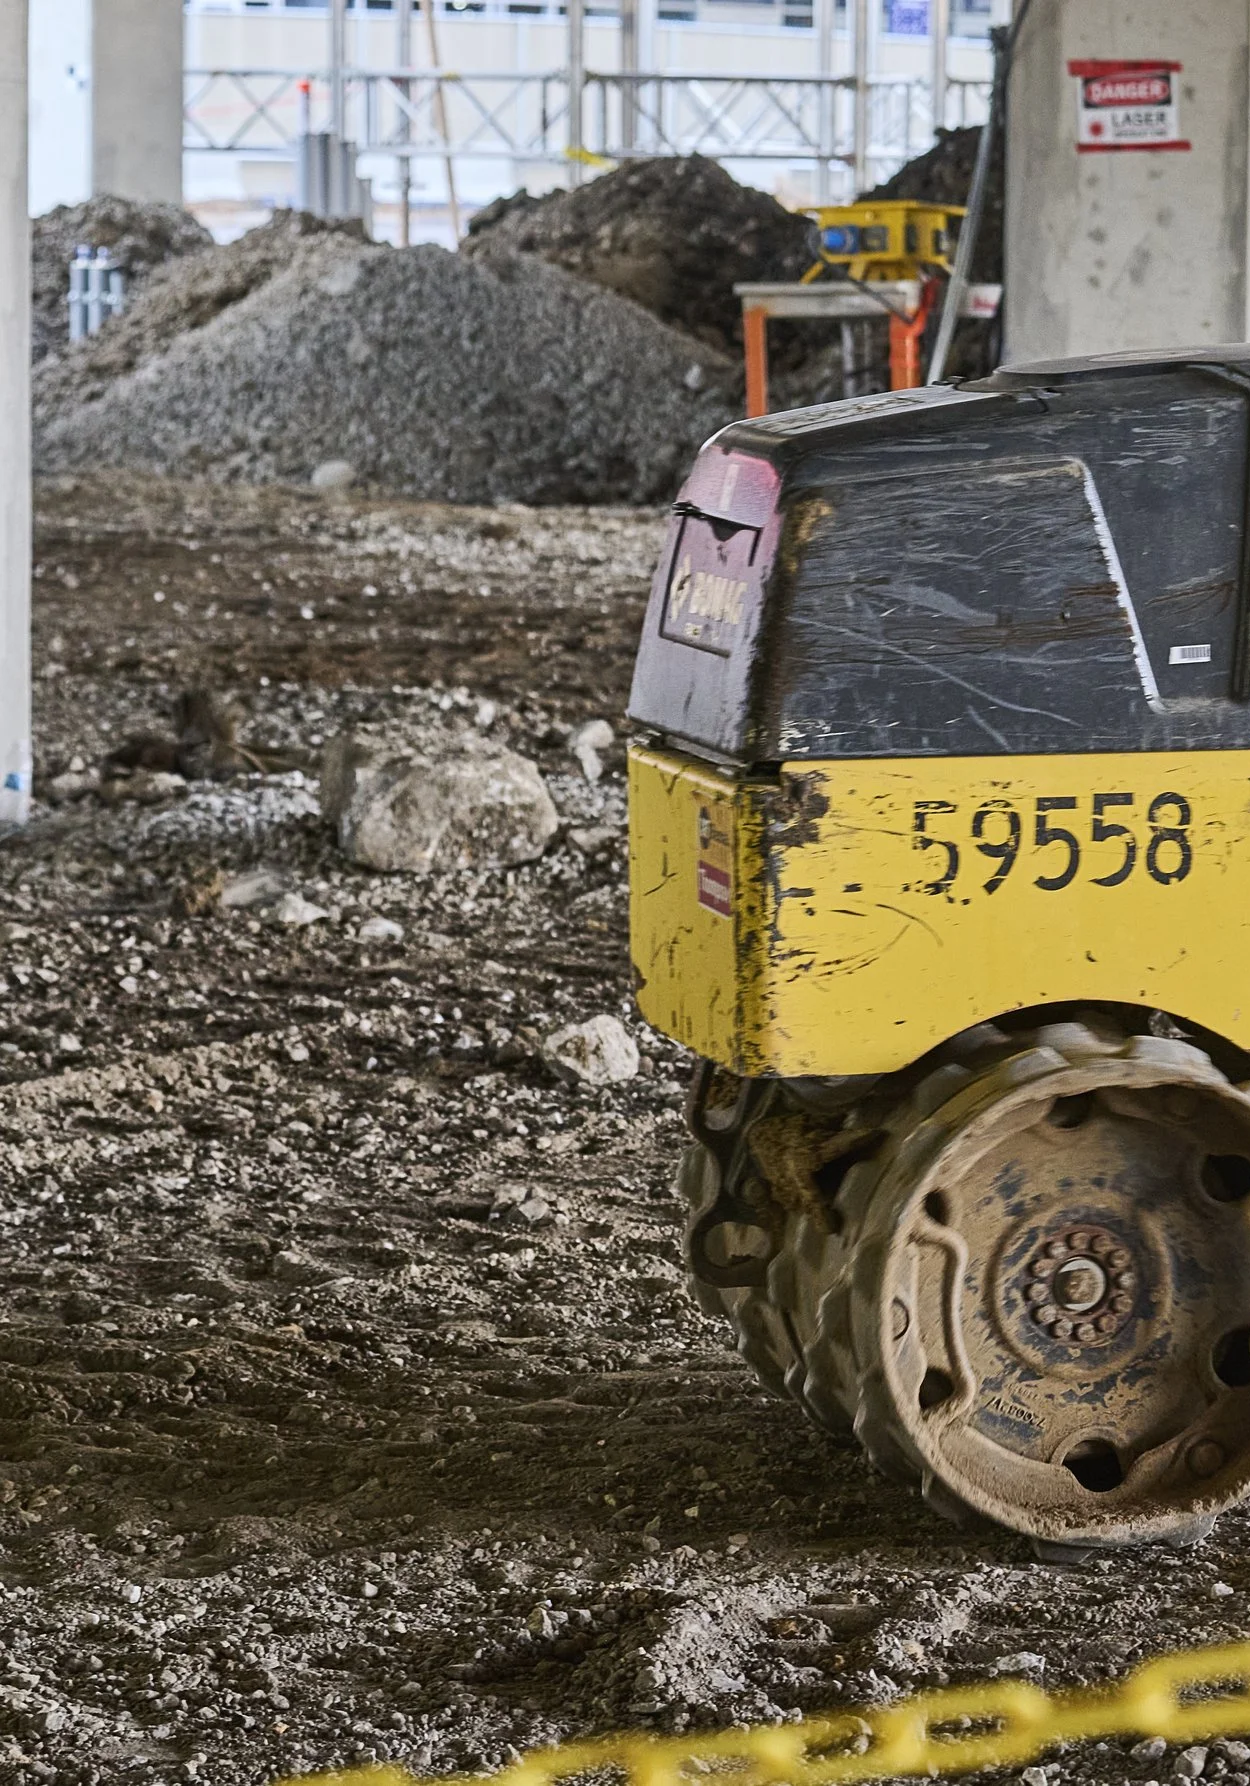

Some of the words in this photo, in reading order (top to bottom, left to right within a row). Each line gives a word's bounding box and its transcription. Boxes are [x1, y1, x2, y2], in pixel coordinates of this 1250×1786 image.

[1091, 80, 1162, 102] DANGER
[1111, 111, 1166, 128] LASER
[911, 791, 1193, 896] 59558
